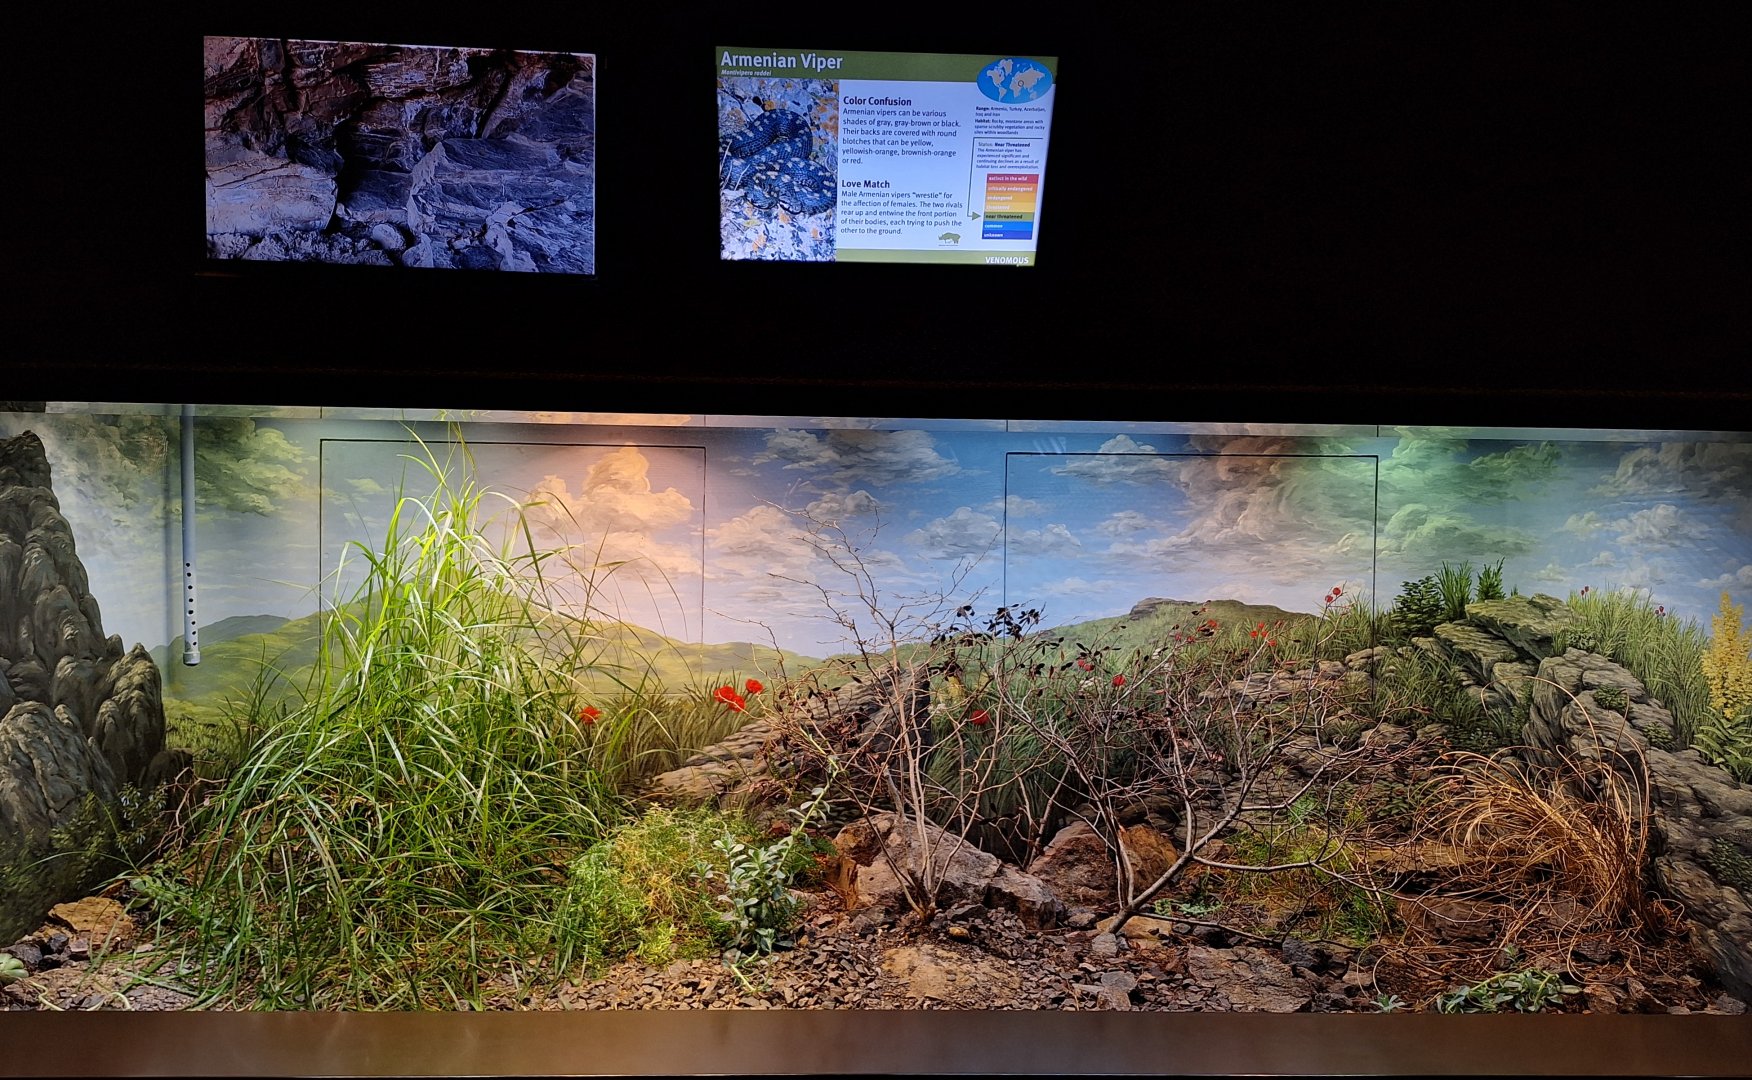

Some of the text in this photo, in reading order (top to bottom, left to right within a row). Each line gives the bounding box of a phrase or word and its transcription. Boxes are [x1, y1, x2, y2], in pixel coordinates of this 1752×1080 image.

[720, 51, 843, 72] Armenian Viper
[843, 96, 912, 106] Color Confusion
